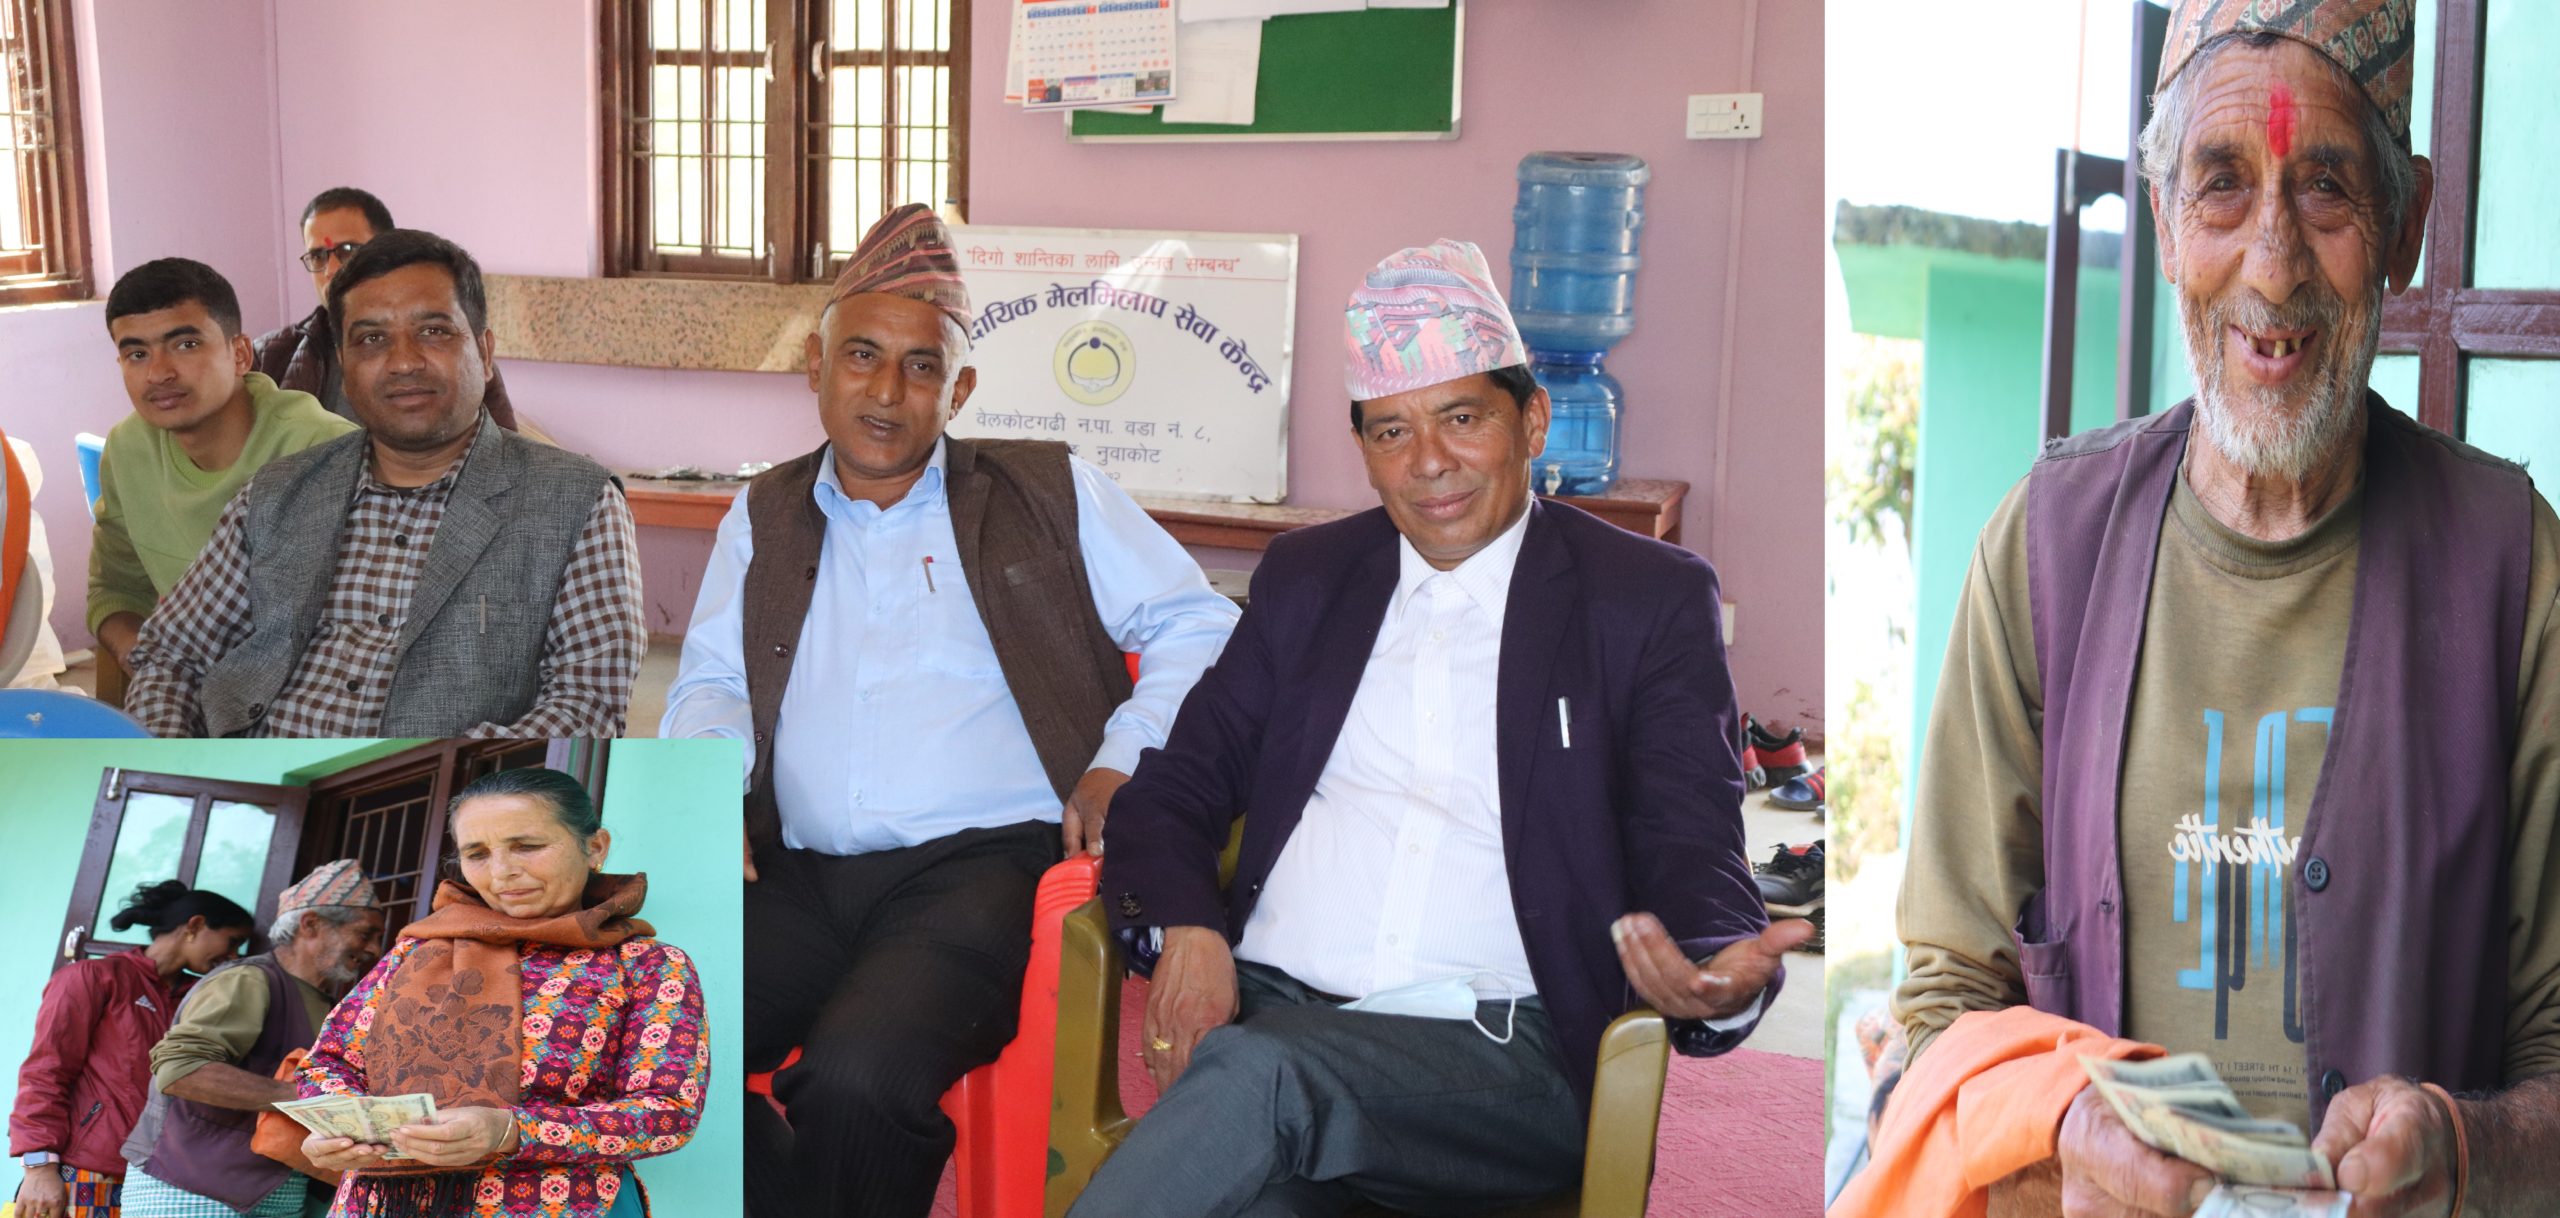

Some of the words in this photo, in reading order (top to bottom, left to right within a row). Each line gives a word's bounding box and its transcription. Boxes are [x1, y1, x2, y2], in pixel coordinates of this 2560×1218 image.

[1016, 247, 1074, 267] शान्तिका
[1085, 249, 1120, 268] लागि
[1046, 280, 1170, 319] मेलमिलाप
[1174, 303, 1220, 344] सेवा
[1219, 339, 1273, 394] केन्द्र
[1125, 419, 1155, 436] वडा
[1097, 442, 1161, 465] नुवाकोट
